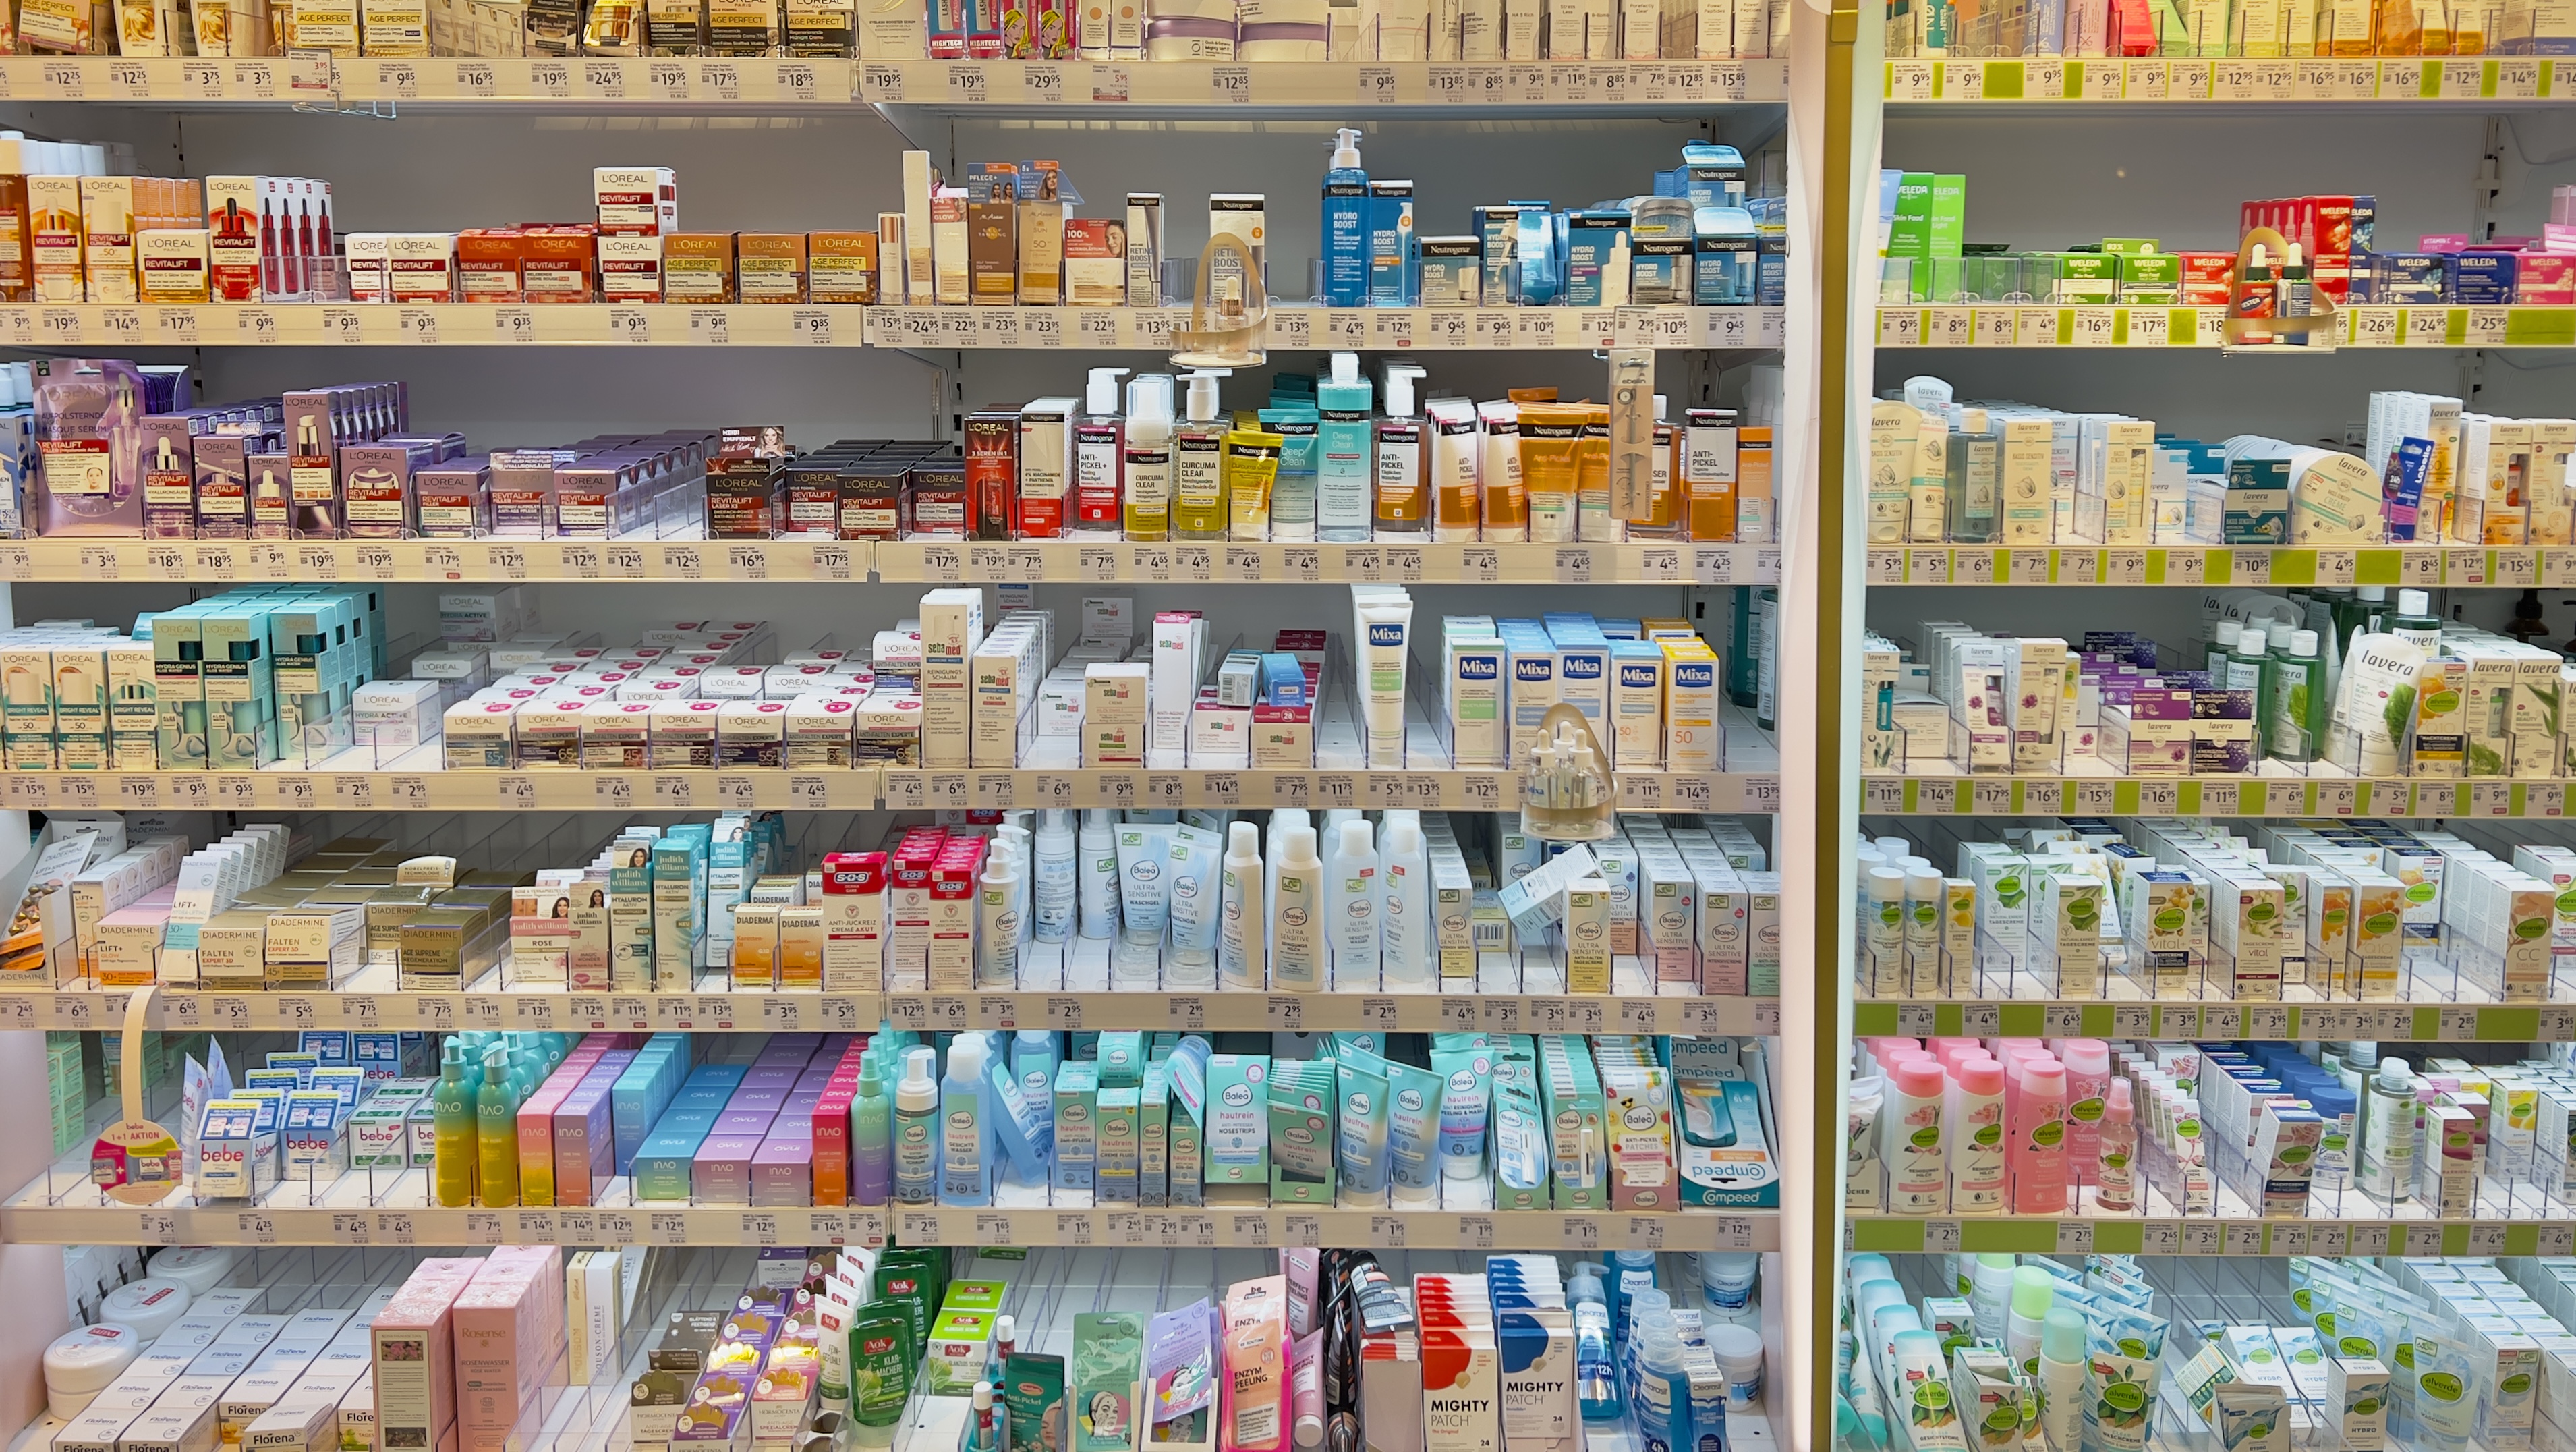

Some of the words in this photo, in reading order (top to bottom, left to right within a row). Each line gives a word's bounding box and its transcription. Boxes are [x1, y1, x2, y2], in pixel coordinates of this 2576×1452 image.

[602, 174, 648, 183] L'ORÉAL
[1698, 171, 1736, 179] Neutrogena
[210, 182, 251, 190] L'ORÉAL
[1067, 230, 1089, 239] 100%
[148, 239, 195, 248] L'ORÉAL
[395, 241, 440, 250] L'ORÉAL
[1430, 246, 1470, 254] Neutrogena
[284, 398, 326, 406] L'ORÉAL
[2430, 409, 2460, 417] lavera
[1872, 417, 1900, 426] lavera
[1081, 435, 1113, 443] Neutrogena
[350, 451, 395, 460] L'ORÉAL
[2338, 457, 2367, 477] lavera
[2415, 445, 2432, 484] Labello
[844, 480, 890, 488] L'ORÉAL
[1371, 630, 1402, 640] Mixa
[1461, 662, 1495, 673] Mixa
[1565, 661, 1599, 672] Mixa
[2361, 650, 2414, 677] lavera
[2473, 661, 2512, 672] lavera
[2518, 662, 2560, 673] lavera
[1622, 672, 1654, 681] Mixa
[1677, 671, 1711, 680] Mixa
[660, 856, 683, 864] judith
[617, 870, 641, 879] judith
[736, 916, 774, 924] DIADERMA
[2152, 939, 2185, 949] vital+
[2517, 949, 2540, 960] CC
[1627, 1115, 1651, 1123] Balea
[131, 1132, 159, 1140] AKTION
[360, 1128, 393, 1140] bebe
[559, 1129, 583, 1137] INAO
[286, 1133, 329, 1150] bebe
[200, 1144, 244, 1162] bebe
[1702, 1190, 1760, 1205] Compeed
[869, 1340, 886, 1348] Aok
[883, 1356, 901, 1365] KLAR-
[878, 1366, 903, 1375] MACHER!
[1234, 1367, 1262, 1379] ENZYM
[1597, 1366, 1612, 1374] 12h
[1234, 1375, 1267, 1389] PEELING
[2425, 1376, 2458, 1393] alverde
[1507, 1382, 1563, 1392] MIGHTY
[1506, 1394, 1543, 1405] PATCH
[2110, 1390, 2138, 1400] alverde
[1431, 1401, 1488, 1412] MIGHTY
[1431, 1415, 1469, 1427] PATCH
[254, 1435, 294, 1445] Florena
